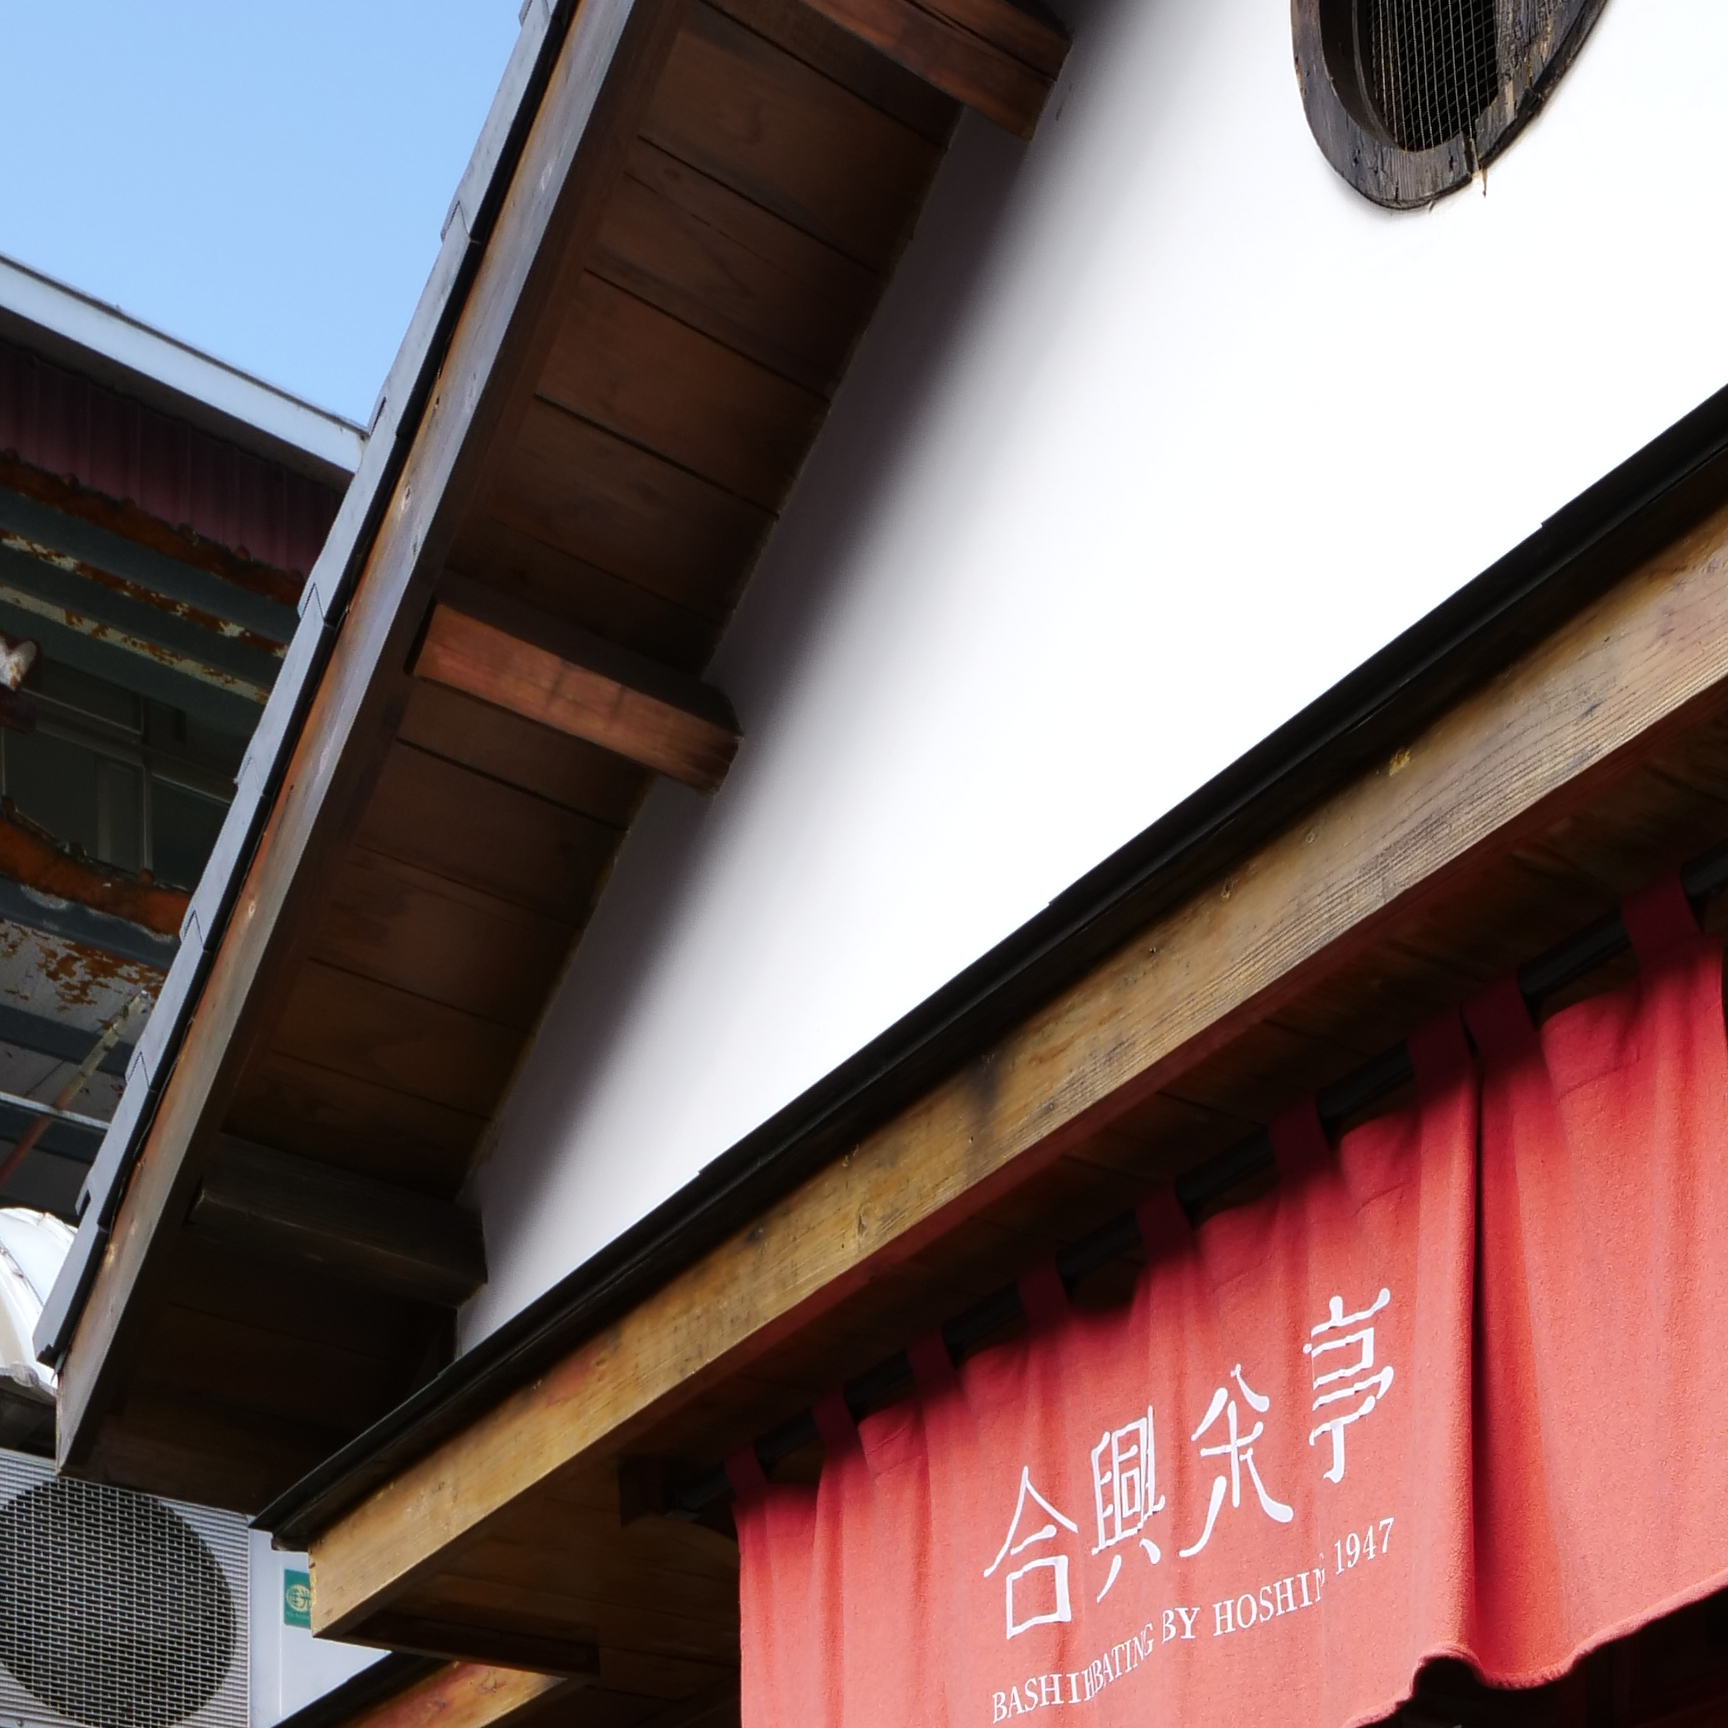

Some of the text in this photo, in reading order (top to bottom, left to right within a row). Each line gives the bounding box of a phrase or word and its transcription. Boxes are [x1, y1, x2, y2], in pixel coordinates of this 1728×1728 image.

[1162, 1607, 1200, 1644] BY
[1212, 1553, 1326, 1637] HOSHIN
[1334, 1517, 1394, 1575] 1947
